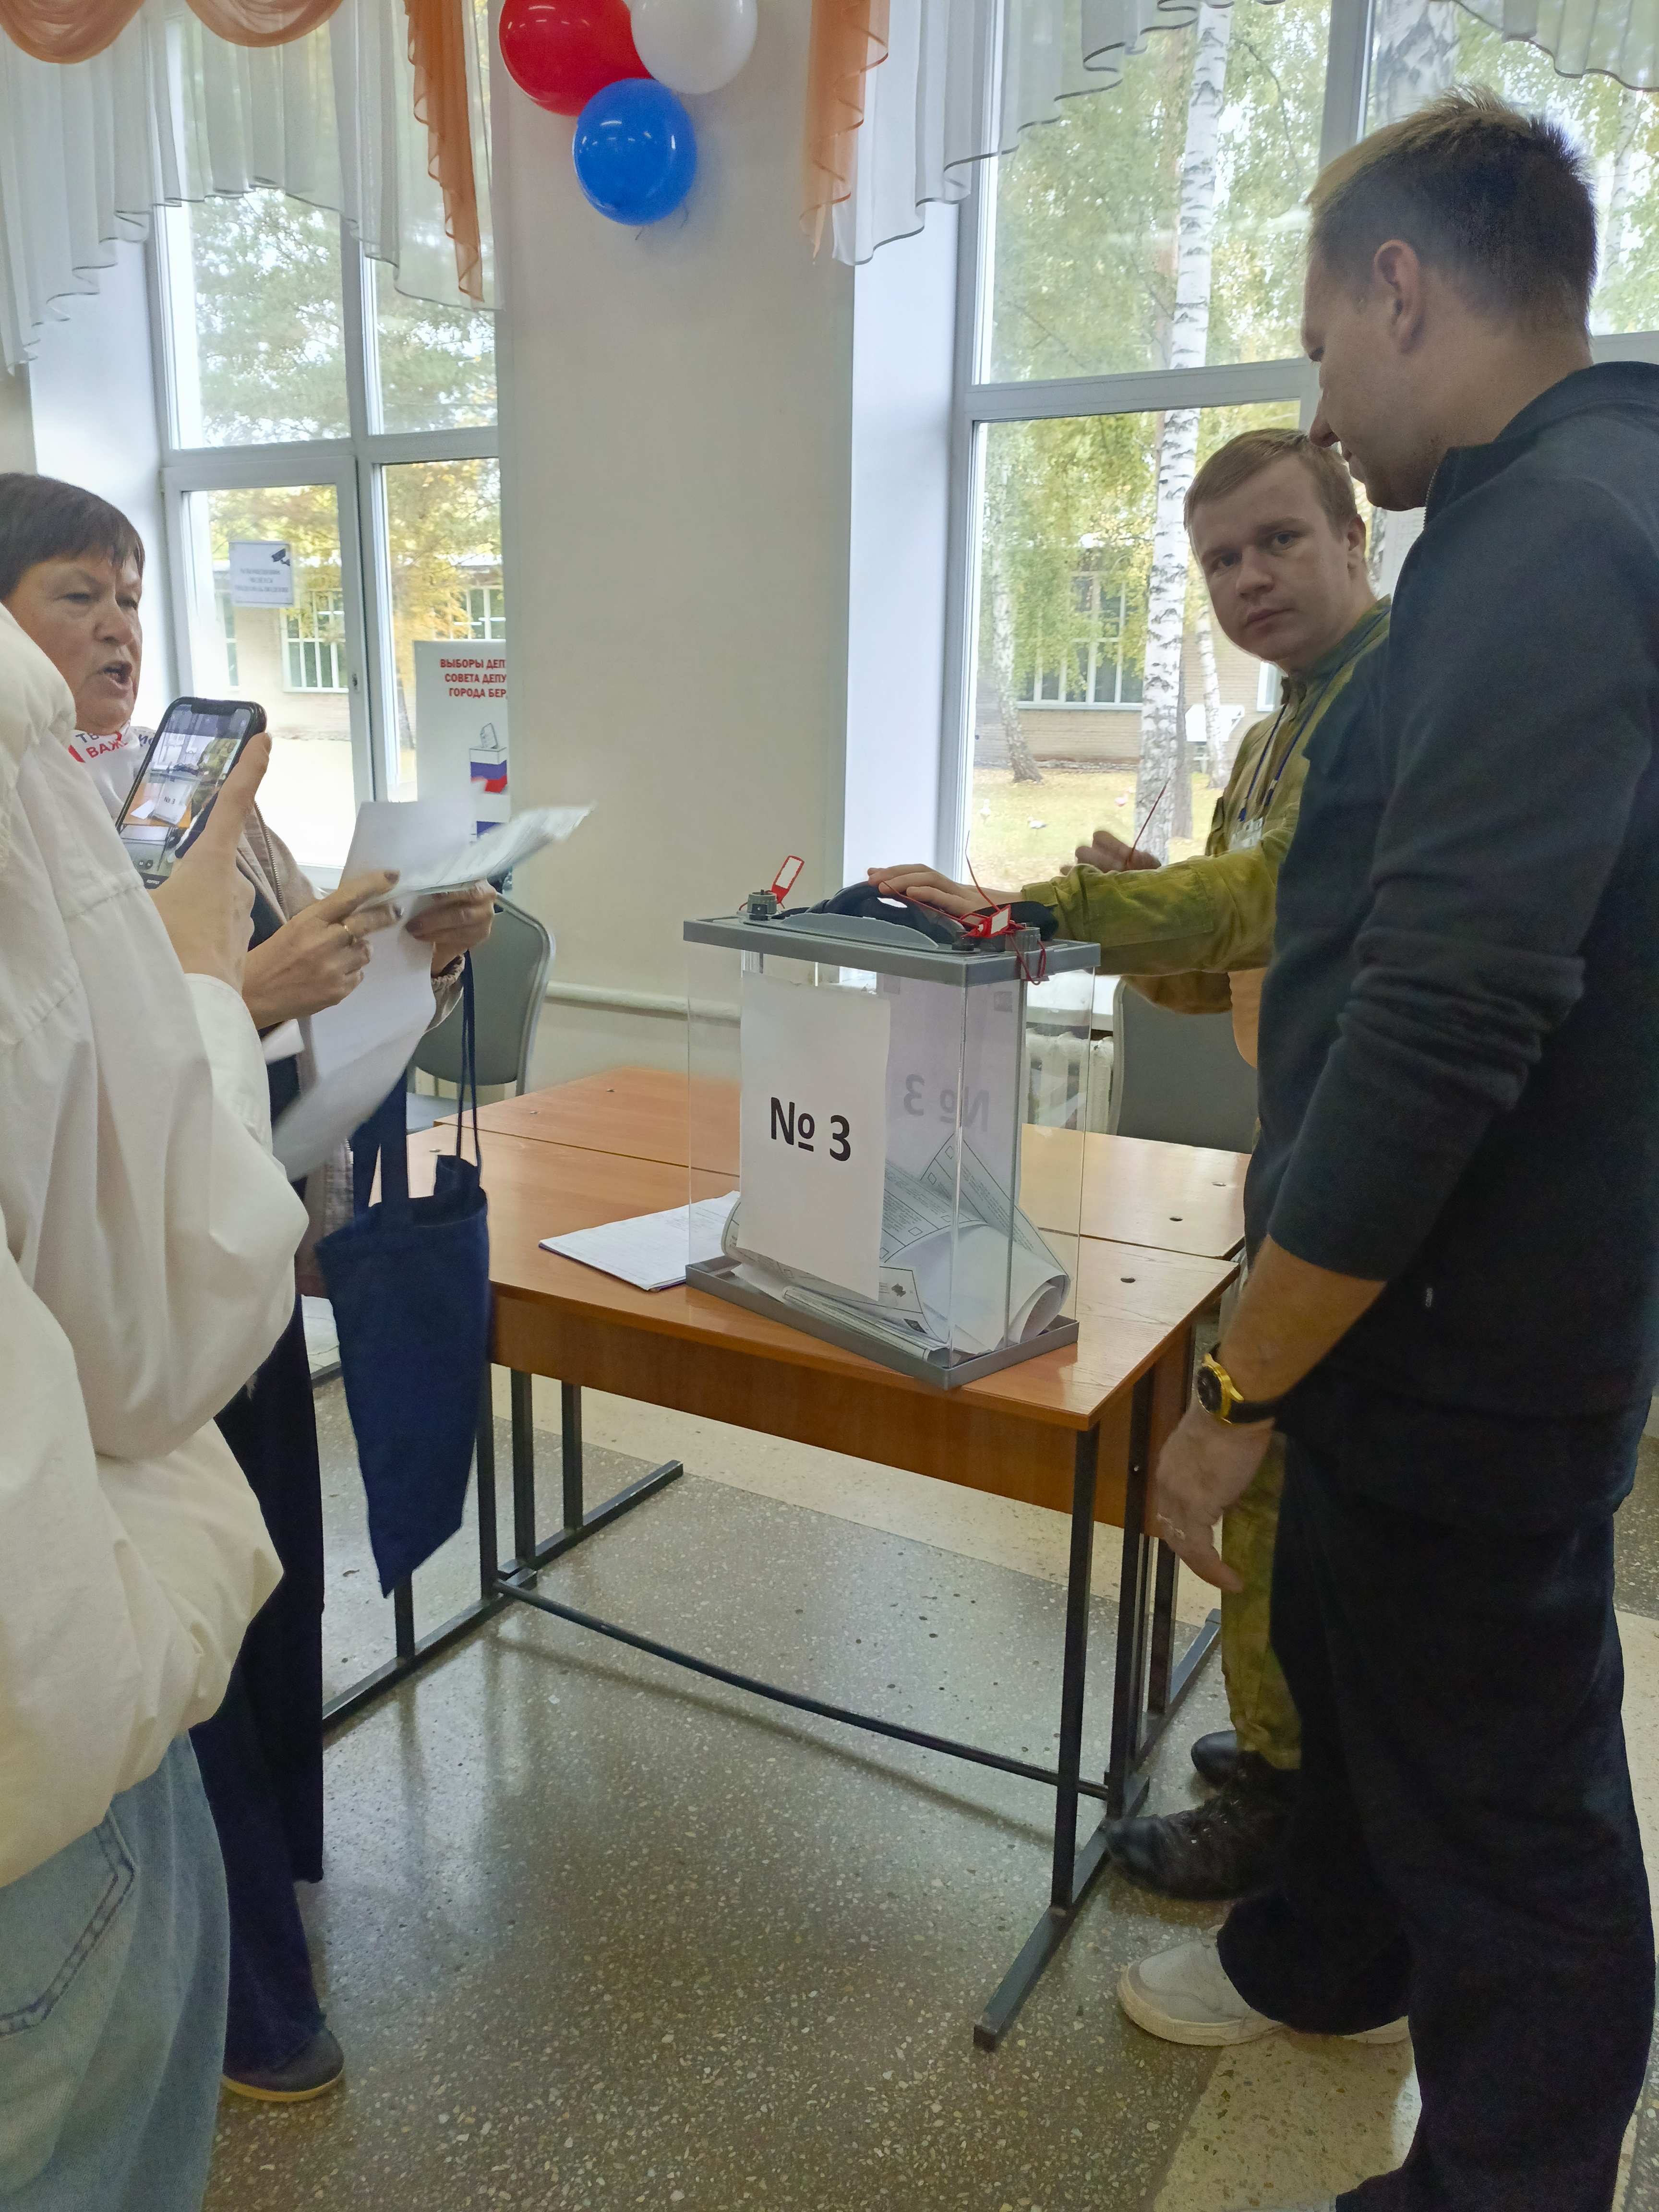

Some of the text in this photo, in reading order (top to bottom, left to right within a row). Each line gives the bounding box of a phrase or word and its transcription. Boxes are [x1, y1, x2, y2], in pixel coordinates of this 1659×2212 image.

[440, 659, 505, 670] ВЫБОРЫ ДЕП
[445, 673, 506, 685] СОВЕТА ДЕПУ
[449, 687, 506, 698] ГОРОДА БЕР
[829, 1115, 852, 1162] 3
